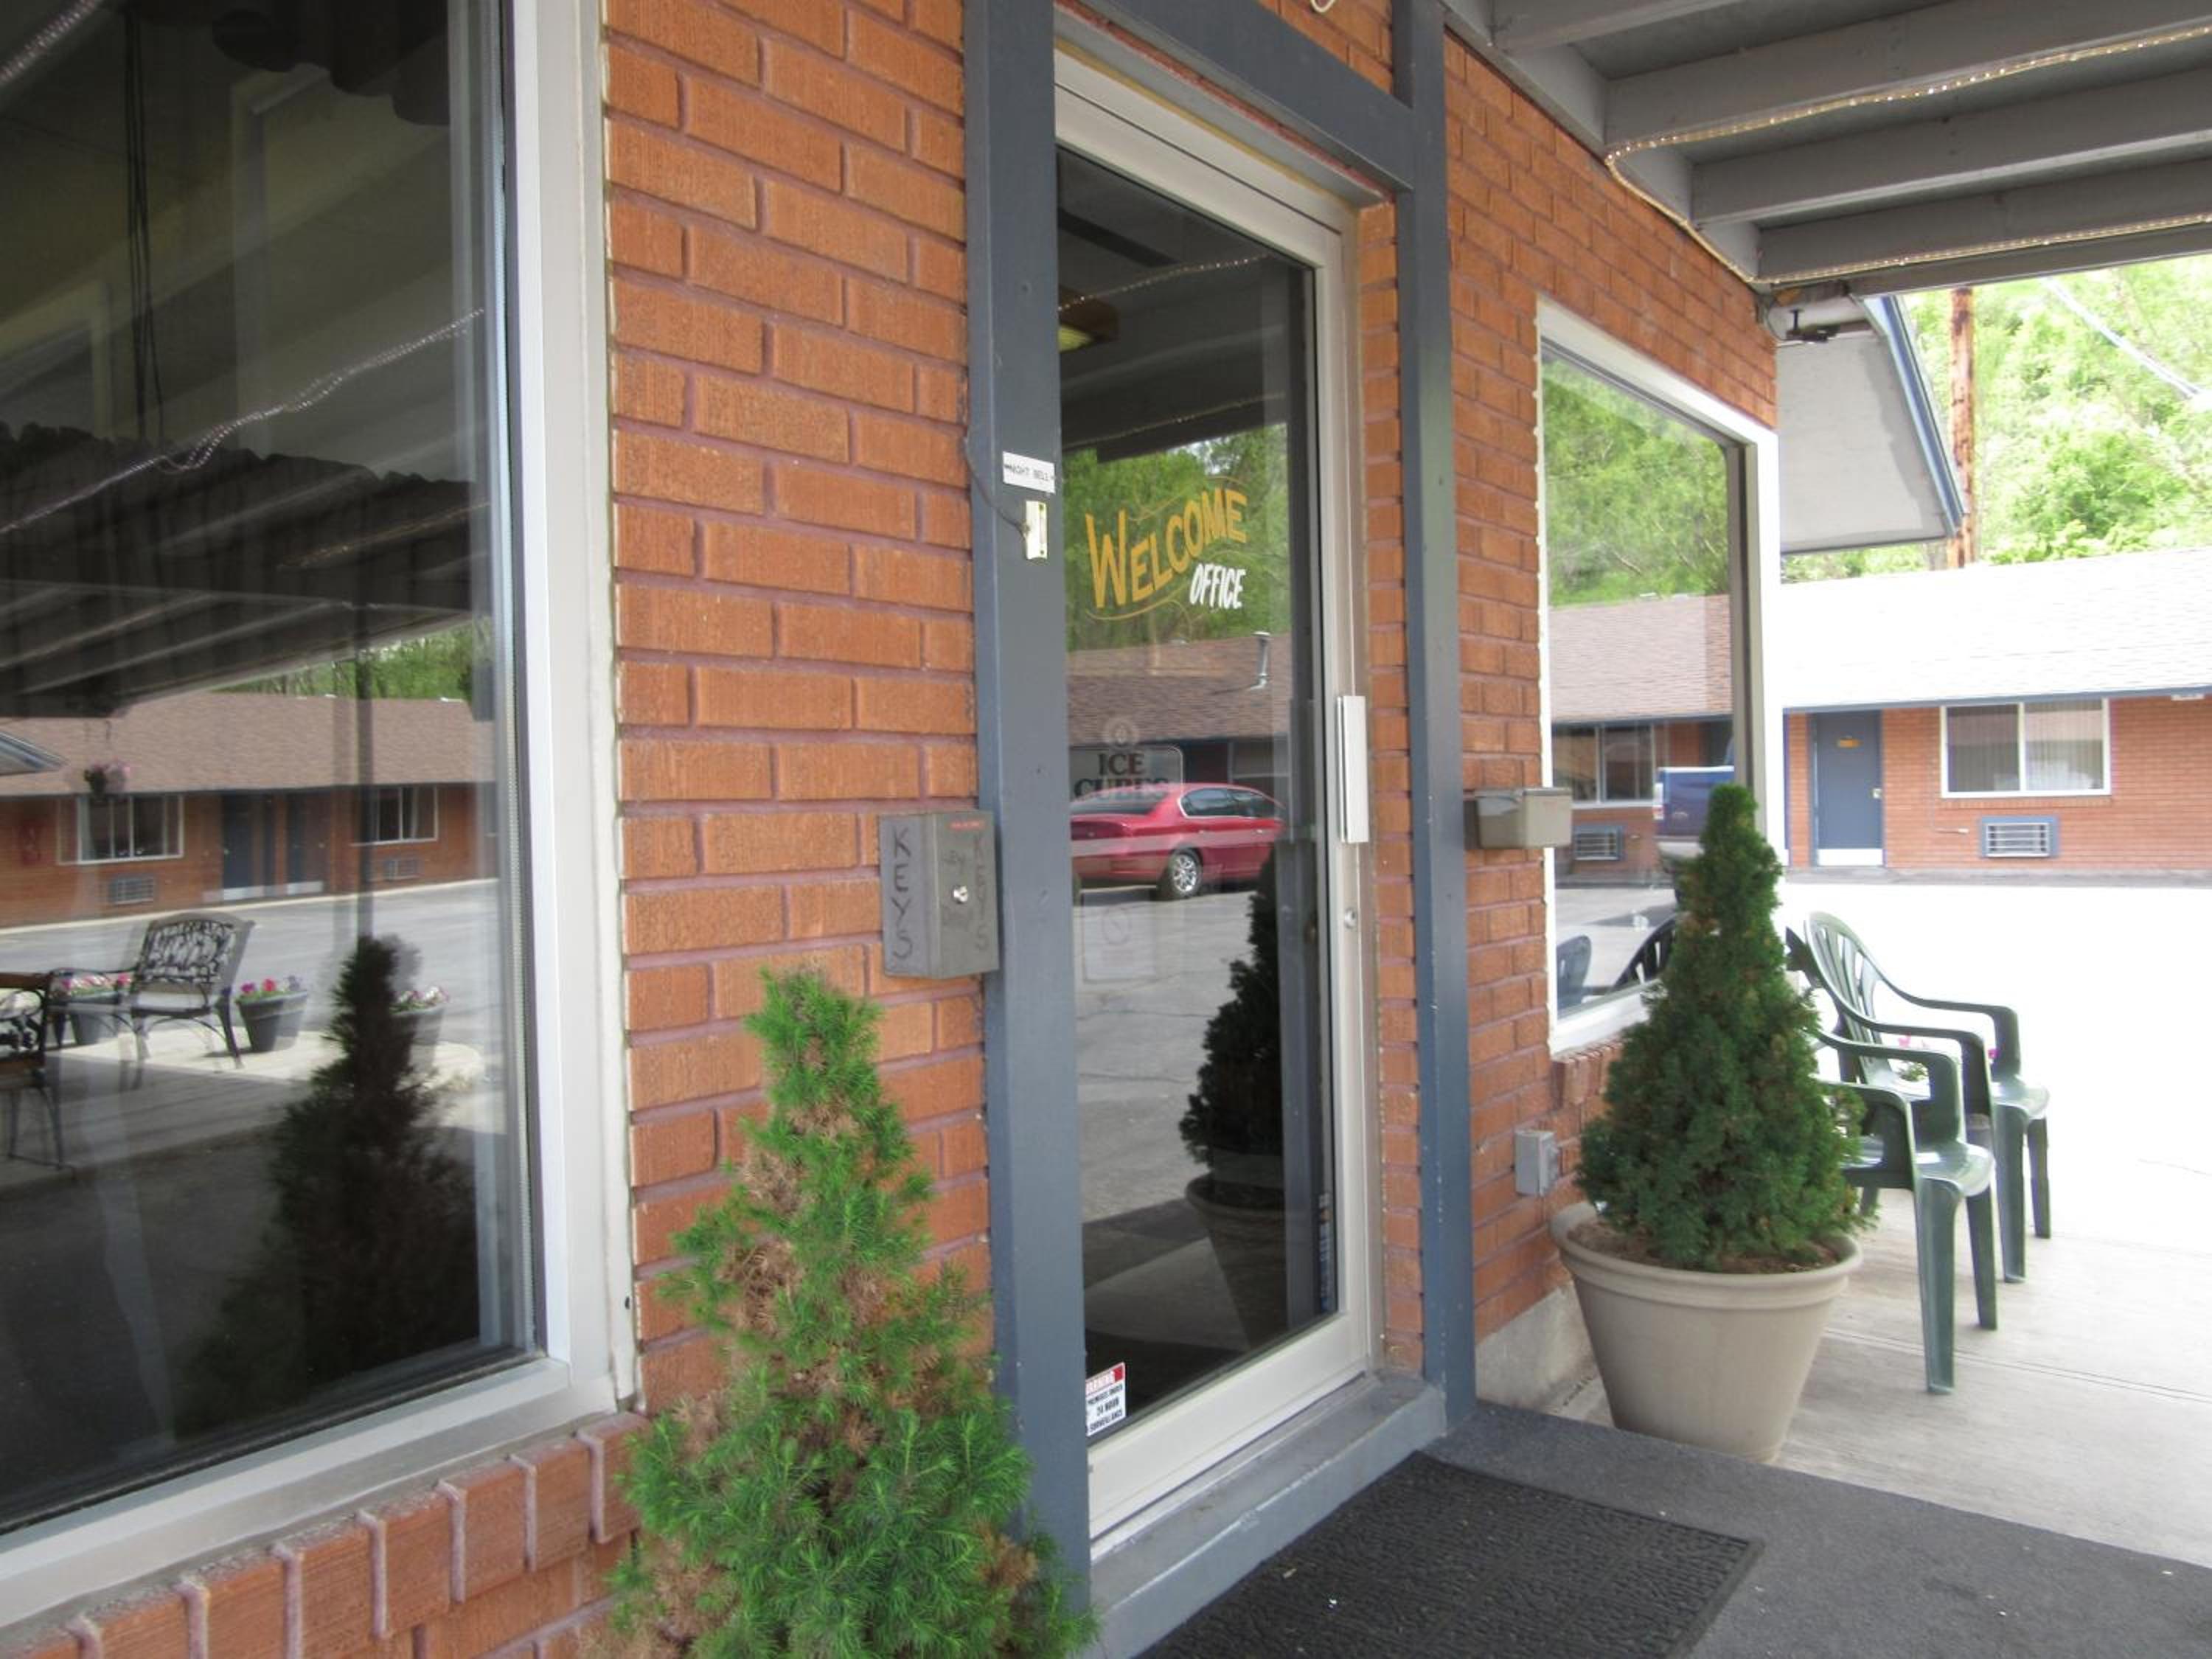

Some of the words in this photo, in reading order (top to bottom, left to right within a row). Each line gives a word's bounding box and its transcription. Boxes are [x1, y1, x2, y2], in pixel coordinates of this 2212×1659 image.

[1085, 487, 1248, 608] WELCOME
[1189, 563, 1246, 609] OFFICE
[1098, 753, 1145, 776] ICE
[891, 826, 913, 958] KEYS
